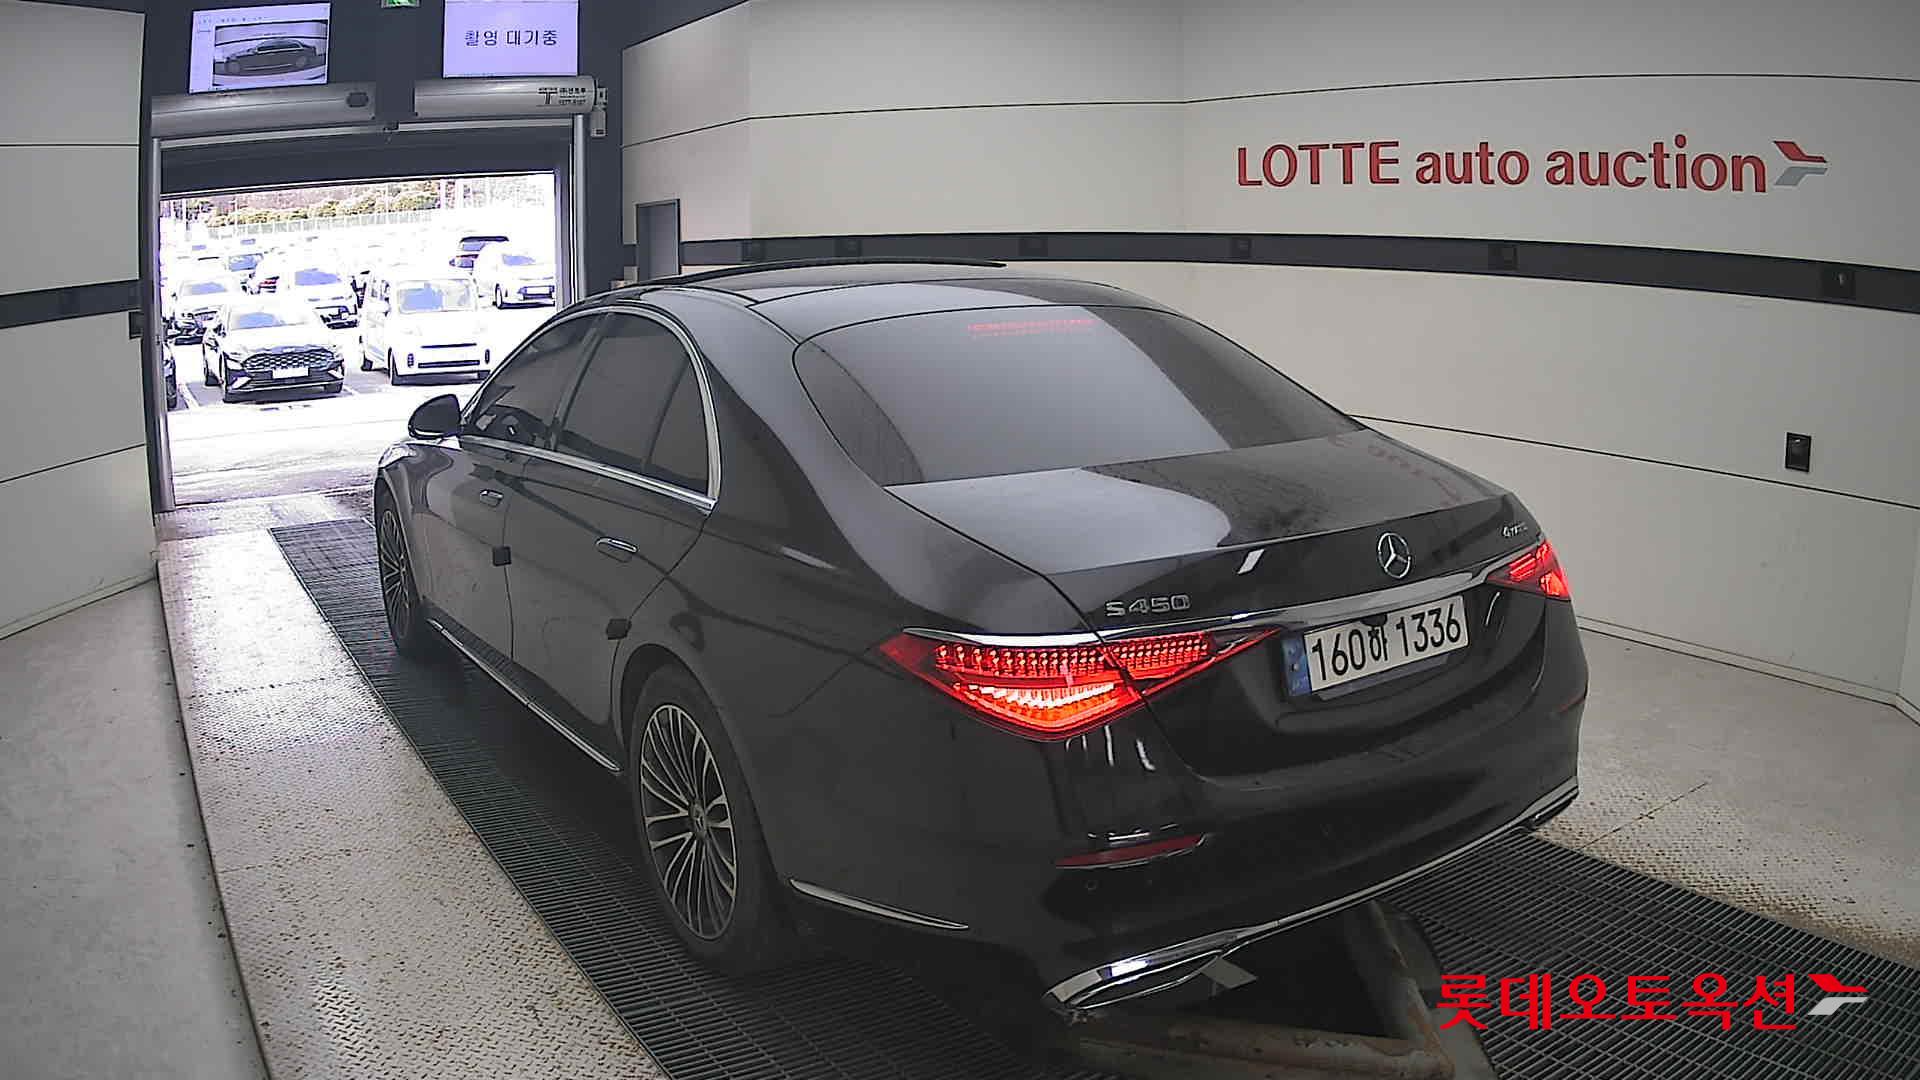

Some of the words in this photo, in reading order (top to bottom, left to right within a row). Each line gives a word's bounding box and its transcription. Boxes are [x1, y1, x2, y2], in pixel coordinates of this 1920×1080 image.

[505, 29, 558, 46] 대기중
[1237, 141, 1399, 187] LOTTE
[1416, 141, 1530, 185] auto
[1546, 135, 1767, 193] auction
[1311, 625, 1389, 681] 160하
[1395, 603, 1462, 657] 1336
